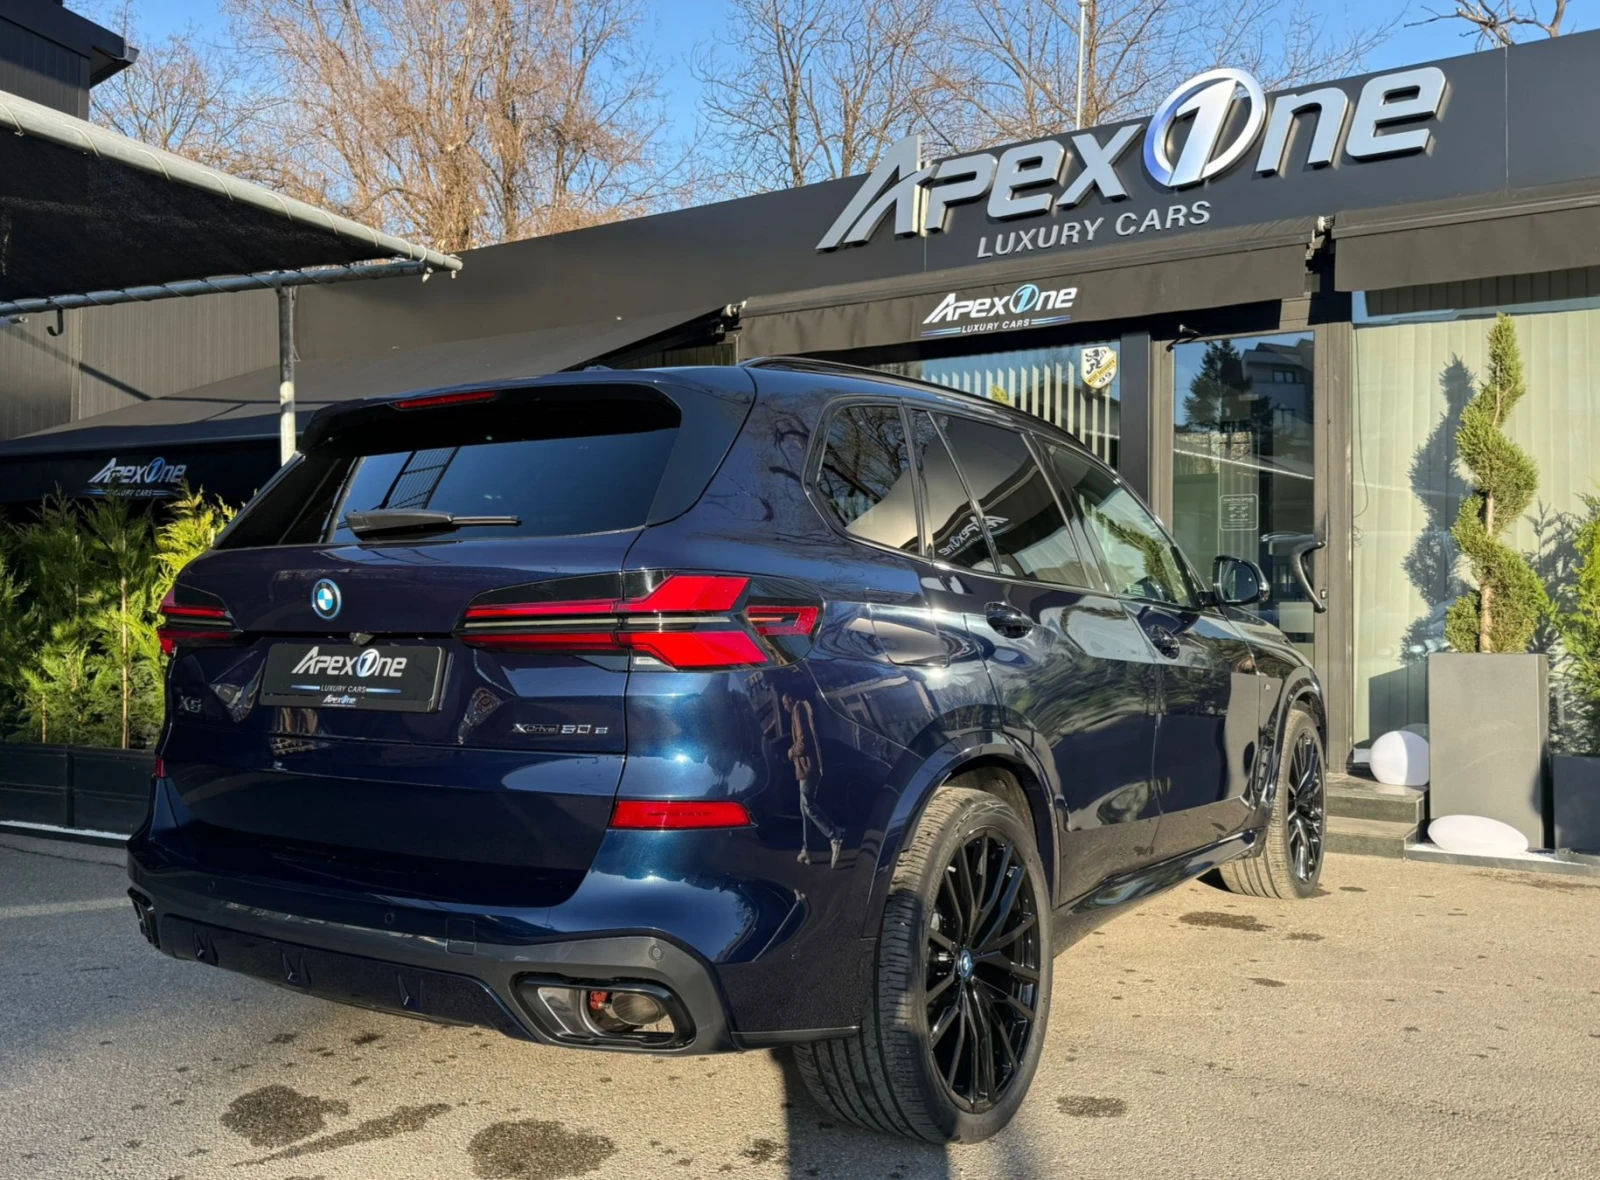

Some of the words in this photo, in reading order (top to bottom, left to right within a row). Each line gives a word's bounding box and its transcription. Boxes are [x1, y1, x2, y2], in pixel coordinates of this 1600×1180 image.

[977, 217, 1104, 259] LUXURY
[1115, 200, 1211, 236] CARS
[962, 322, 1000, 334] LUXURY
[1002, 319, 1030, 330] CARS
[136, 489, 153, 497] CARS
[320, 684, 347, 693] LUXURY
[348, 685, 366, 694] CARS
